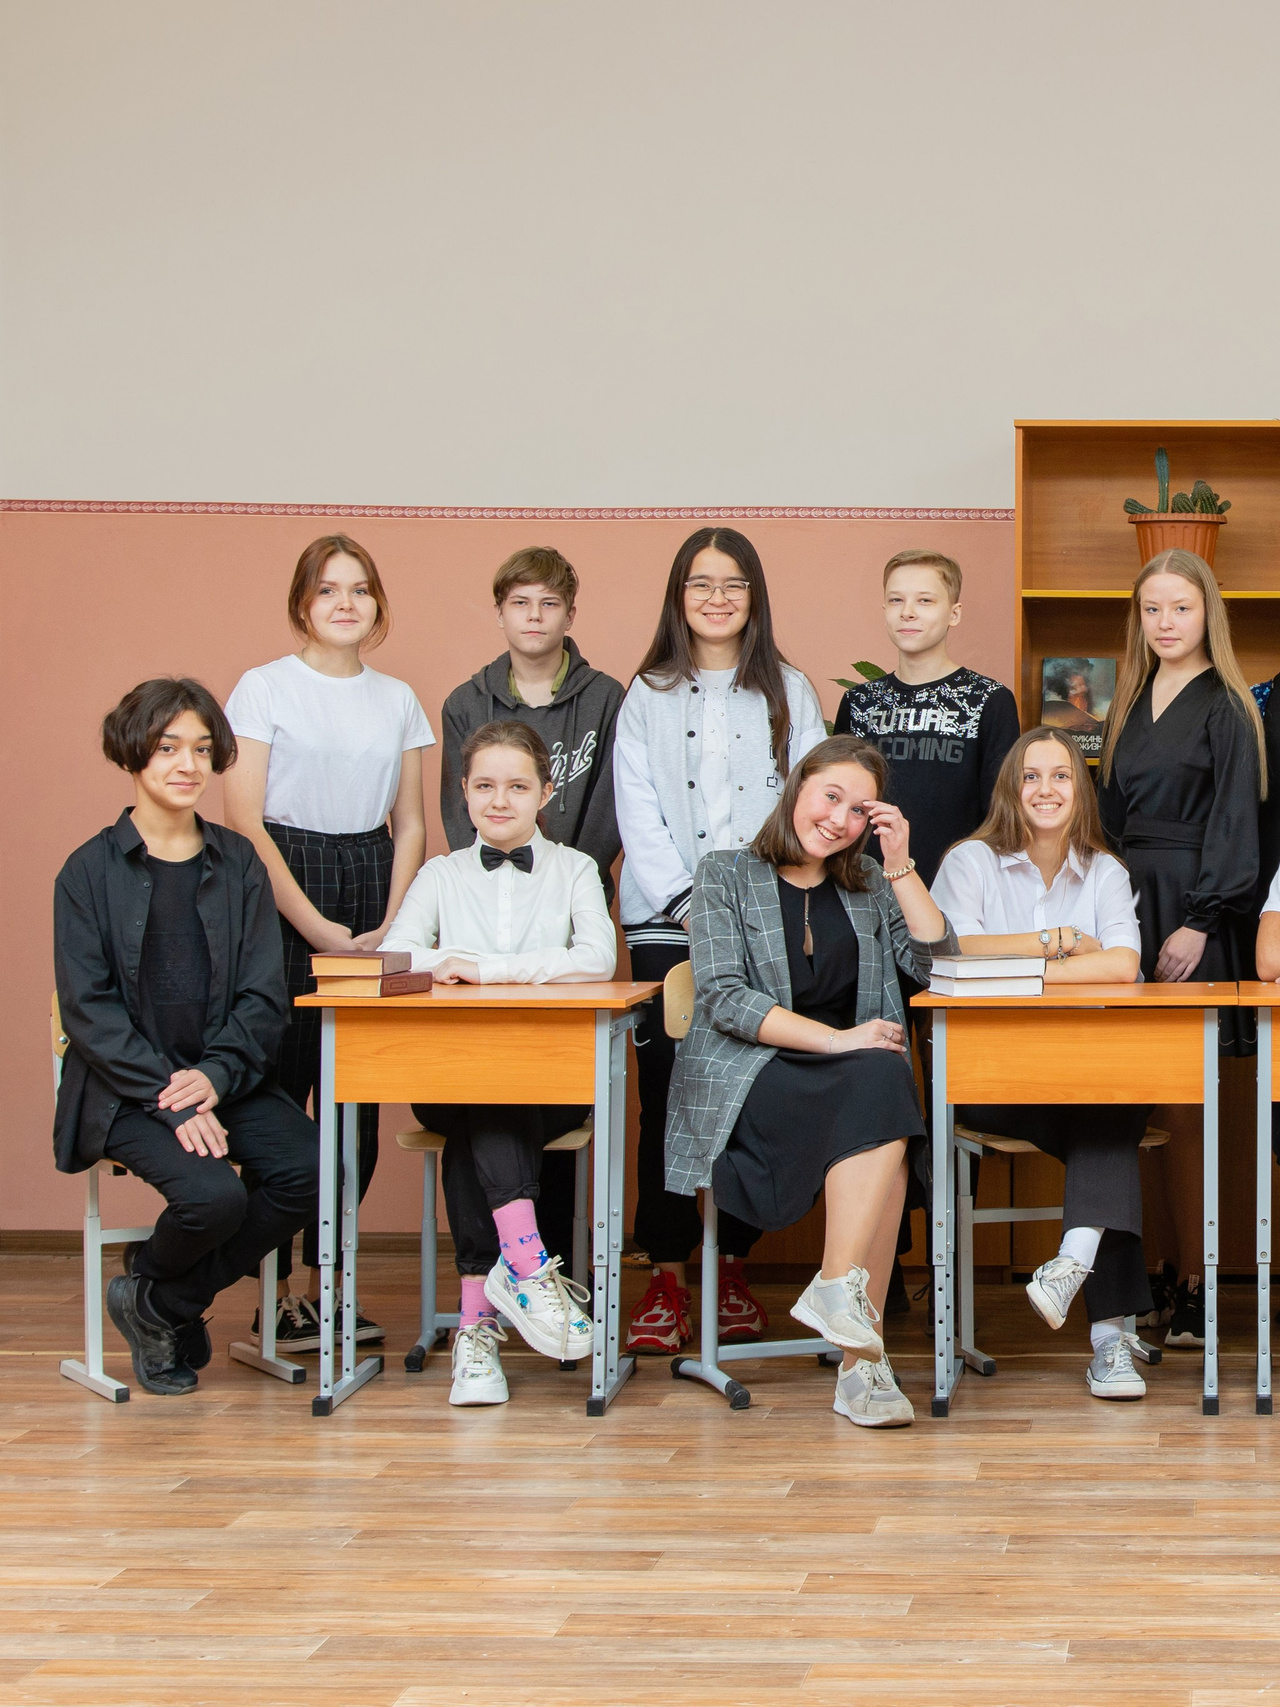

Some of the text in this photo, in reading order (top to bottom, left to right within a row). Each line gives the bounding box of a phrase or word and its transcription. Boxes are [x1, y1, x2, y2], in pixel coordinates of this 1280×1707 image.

[868, 707, 960, 734] FUTURE
[878, 737, 965, 763] COMING
[1079, 742, 1102, 751] ЖИЗН
